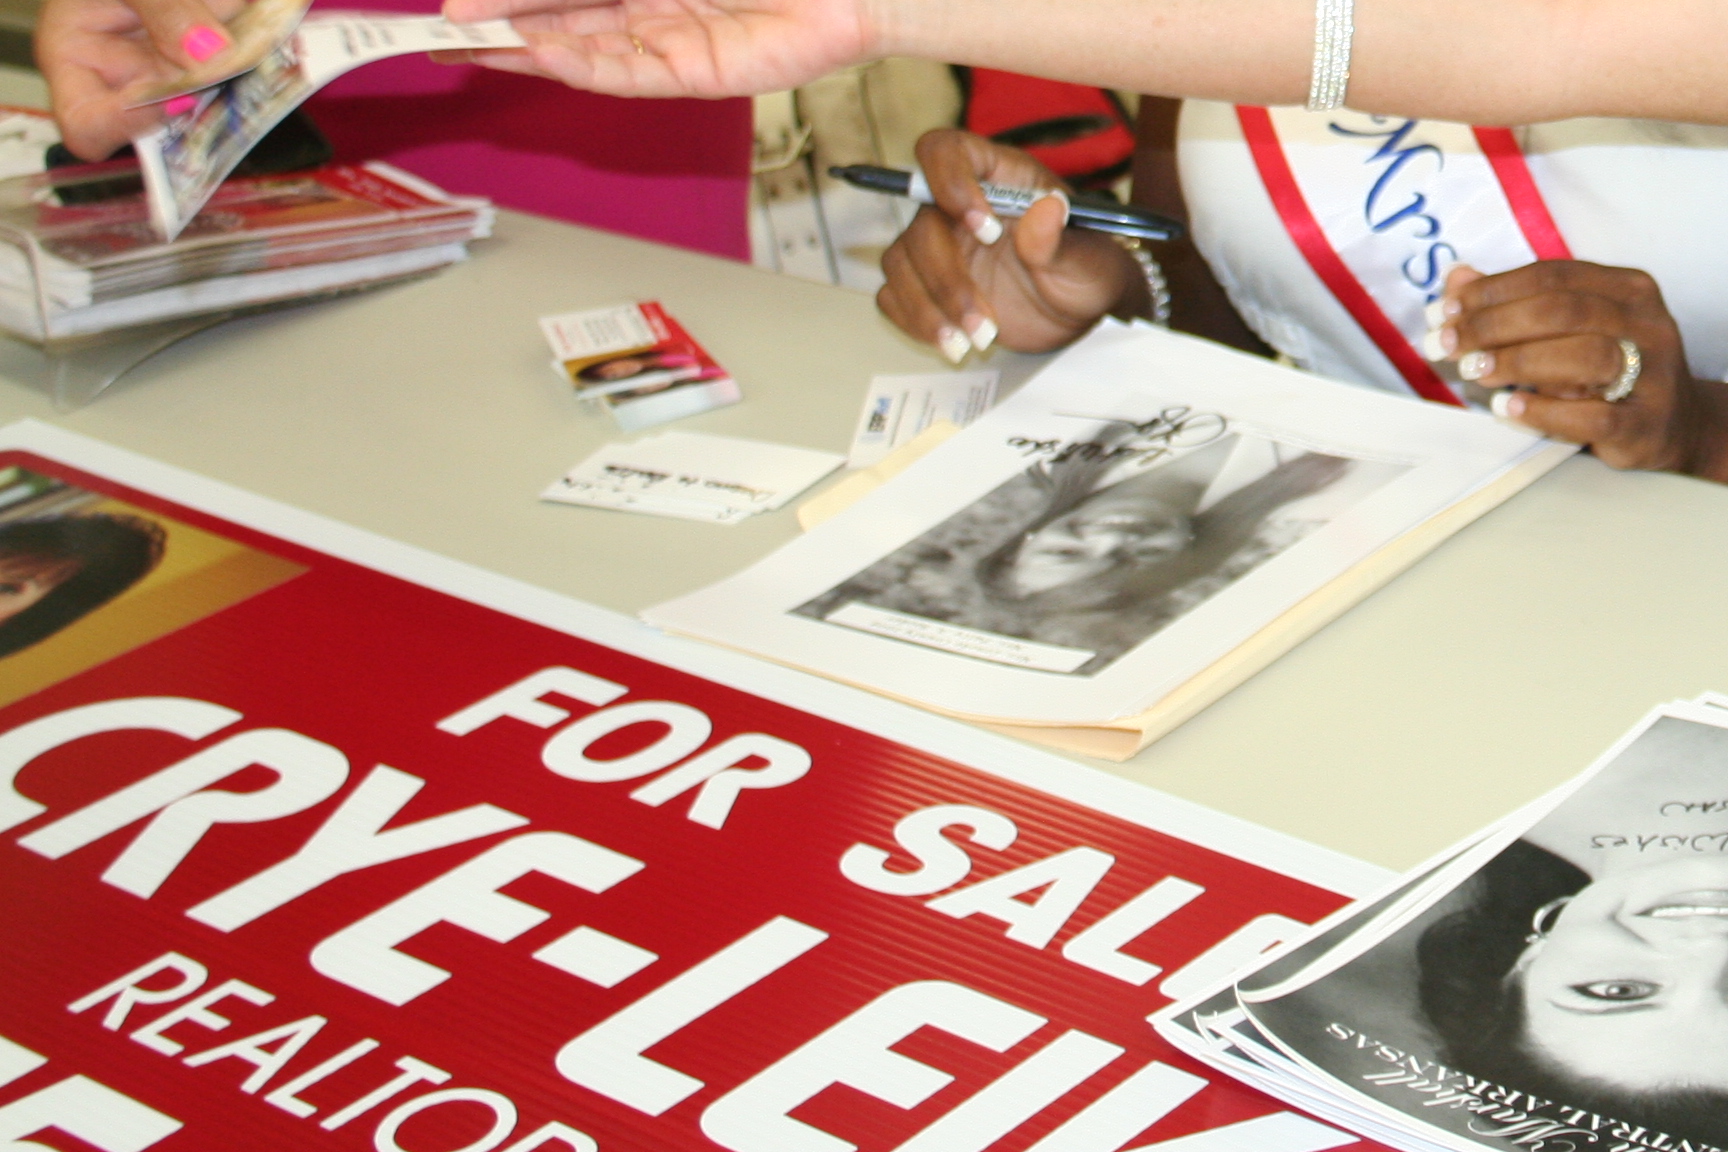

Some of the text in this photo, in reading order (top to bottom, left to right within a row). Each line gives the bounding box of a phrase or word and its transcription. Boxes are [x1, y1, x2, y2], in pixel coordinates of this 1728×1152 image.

[1329, 113, 1458, 303] Mrs.
[434, 664, 813, 830] FOR
[66, 950, 600, 1152] REALTO
[1325, 1022, 1554, 1112] ARKANSAS
[1362, 1069, 1599, 1152] Marshall
